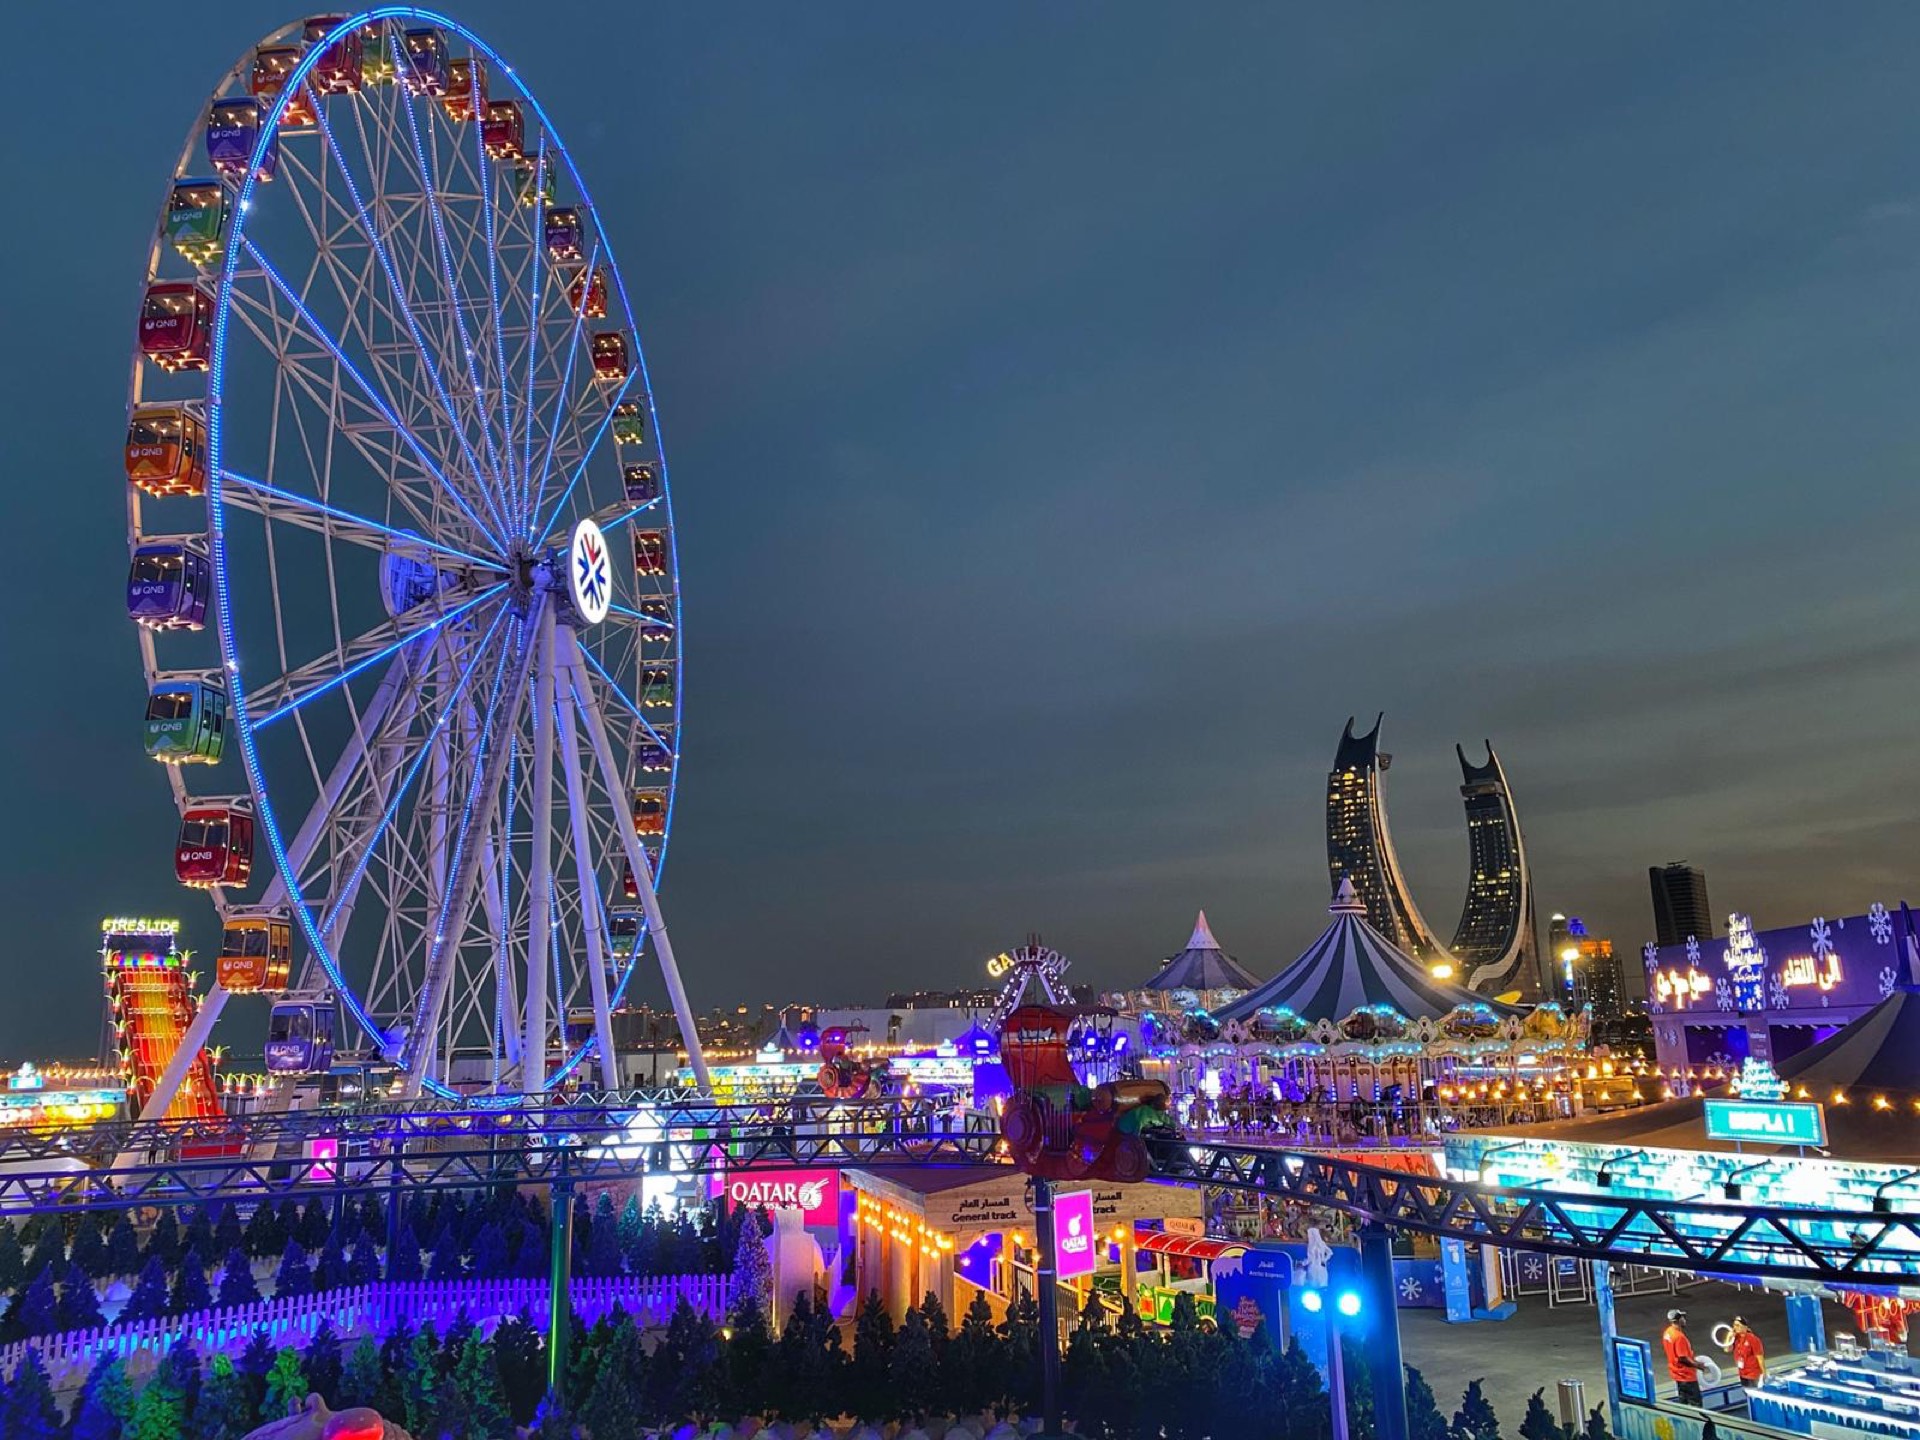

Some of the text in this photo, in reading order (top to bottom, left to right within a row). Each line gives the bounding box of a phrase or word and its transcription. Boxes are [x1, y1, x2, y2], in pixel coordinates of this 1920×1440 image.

[156, 319, 177, 328] QNB
[141, 447, 163, 456] QNB
[142, 585, 164, 594] QNB
[161, 722, 182, 731] QNB
[191, 851, 212, 860] QNB
[102, 918, 180, 932] FIRESLIDE
[233, 960, 253, 969] QNB
[987, 945, 1072, 977] GALLEON
[731, 1182, 797, 1202] QATAR
[981, 1198, 1010, 1210] المسار
[1093, 1204, 1116, 1214] track
[952, 1210, 1017, 1223] General track
[1062, 1235, 1088, 1250] QATAR
